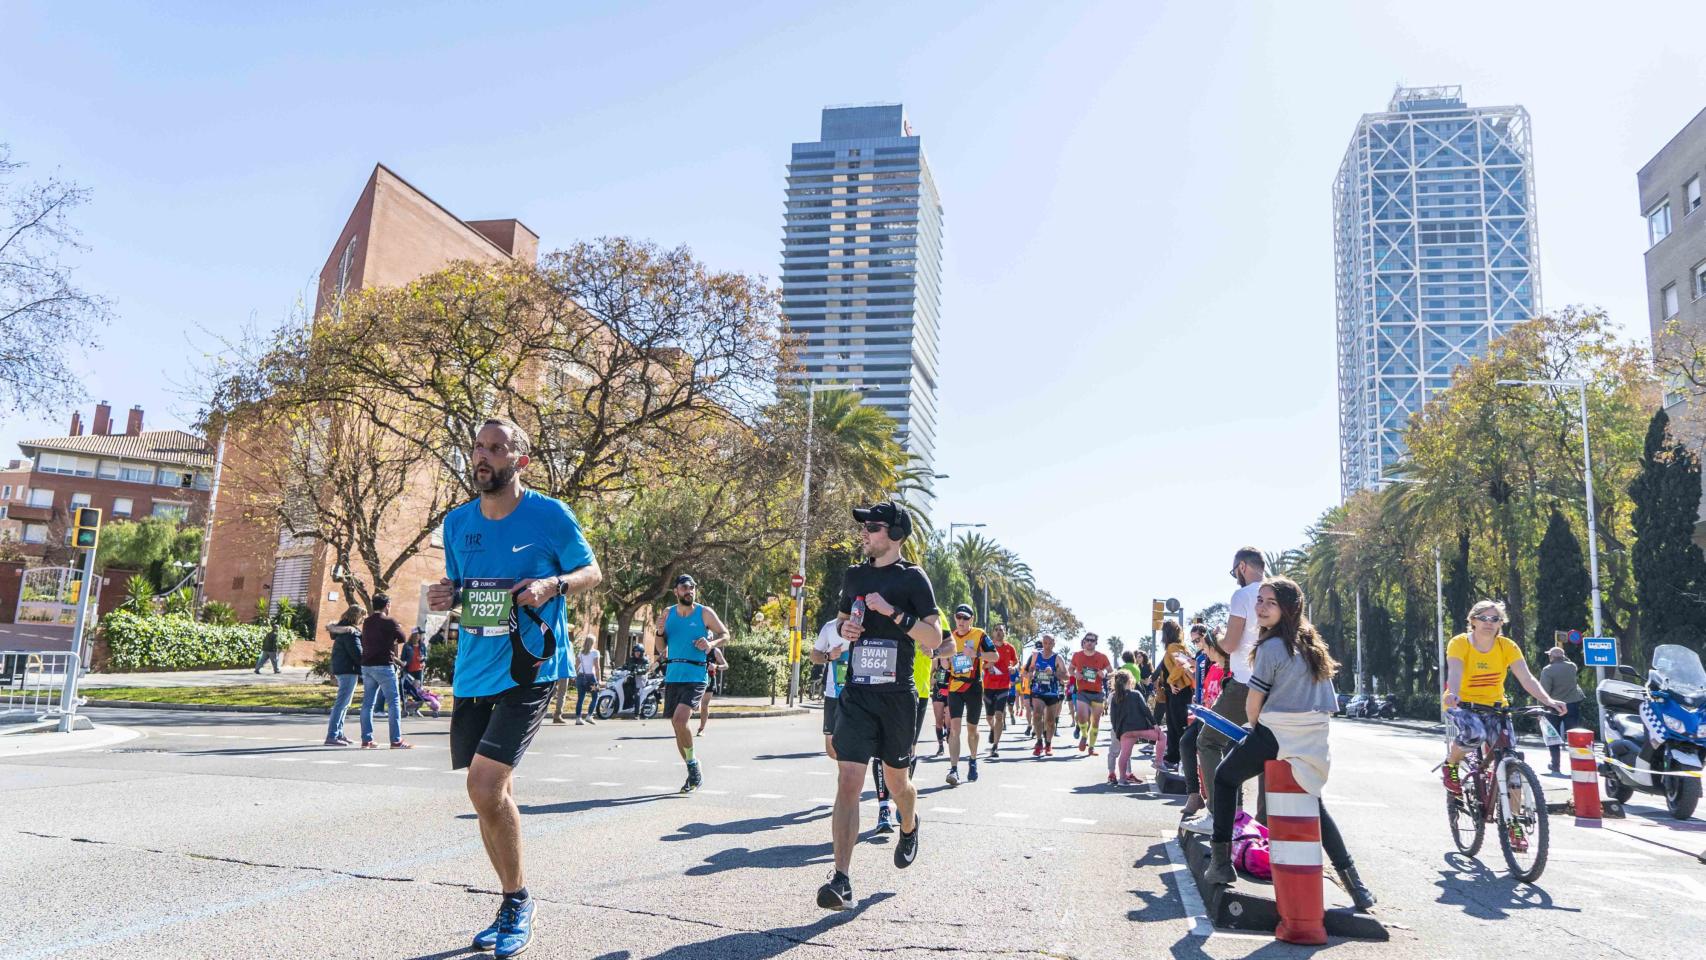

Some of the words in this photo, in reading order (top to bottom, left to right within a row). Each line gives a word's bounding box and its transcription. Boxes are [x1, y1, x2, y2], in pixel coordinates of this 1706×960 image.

[468, 591, 507, 602] PICAUT
[471, 603, 504, 617] 7327
[862, 648, 888, 658] EWAN
[860, 657, 887, 669] 3664
